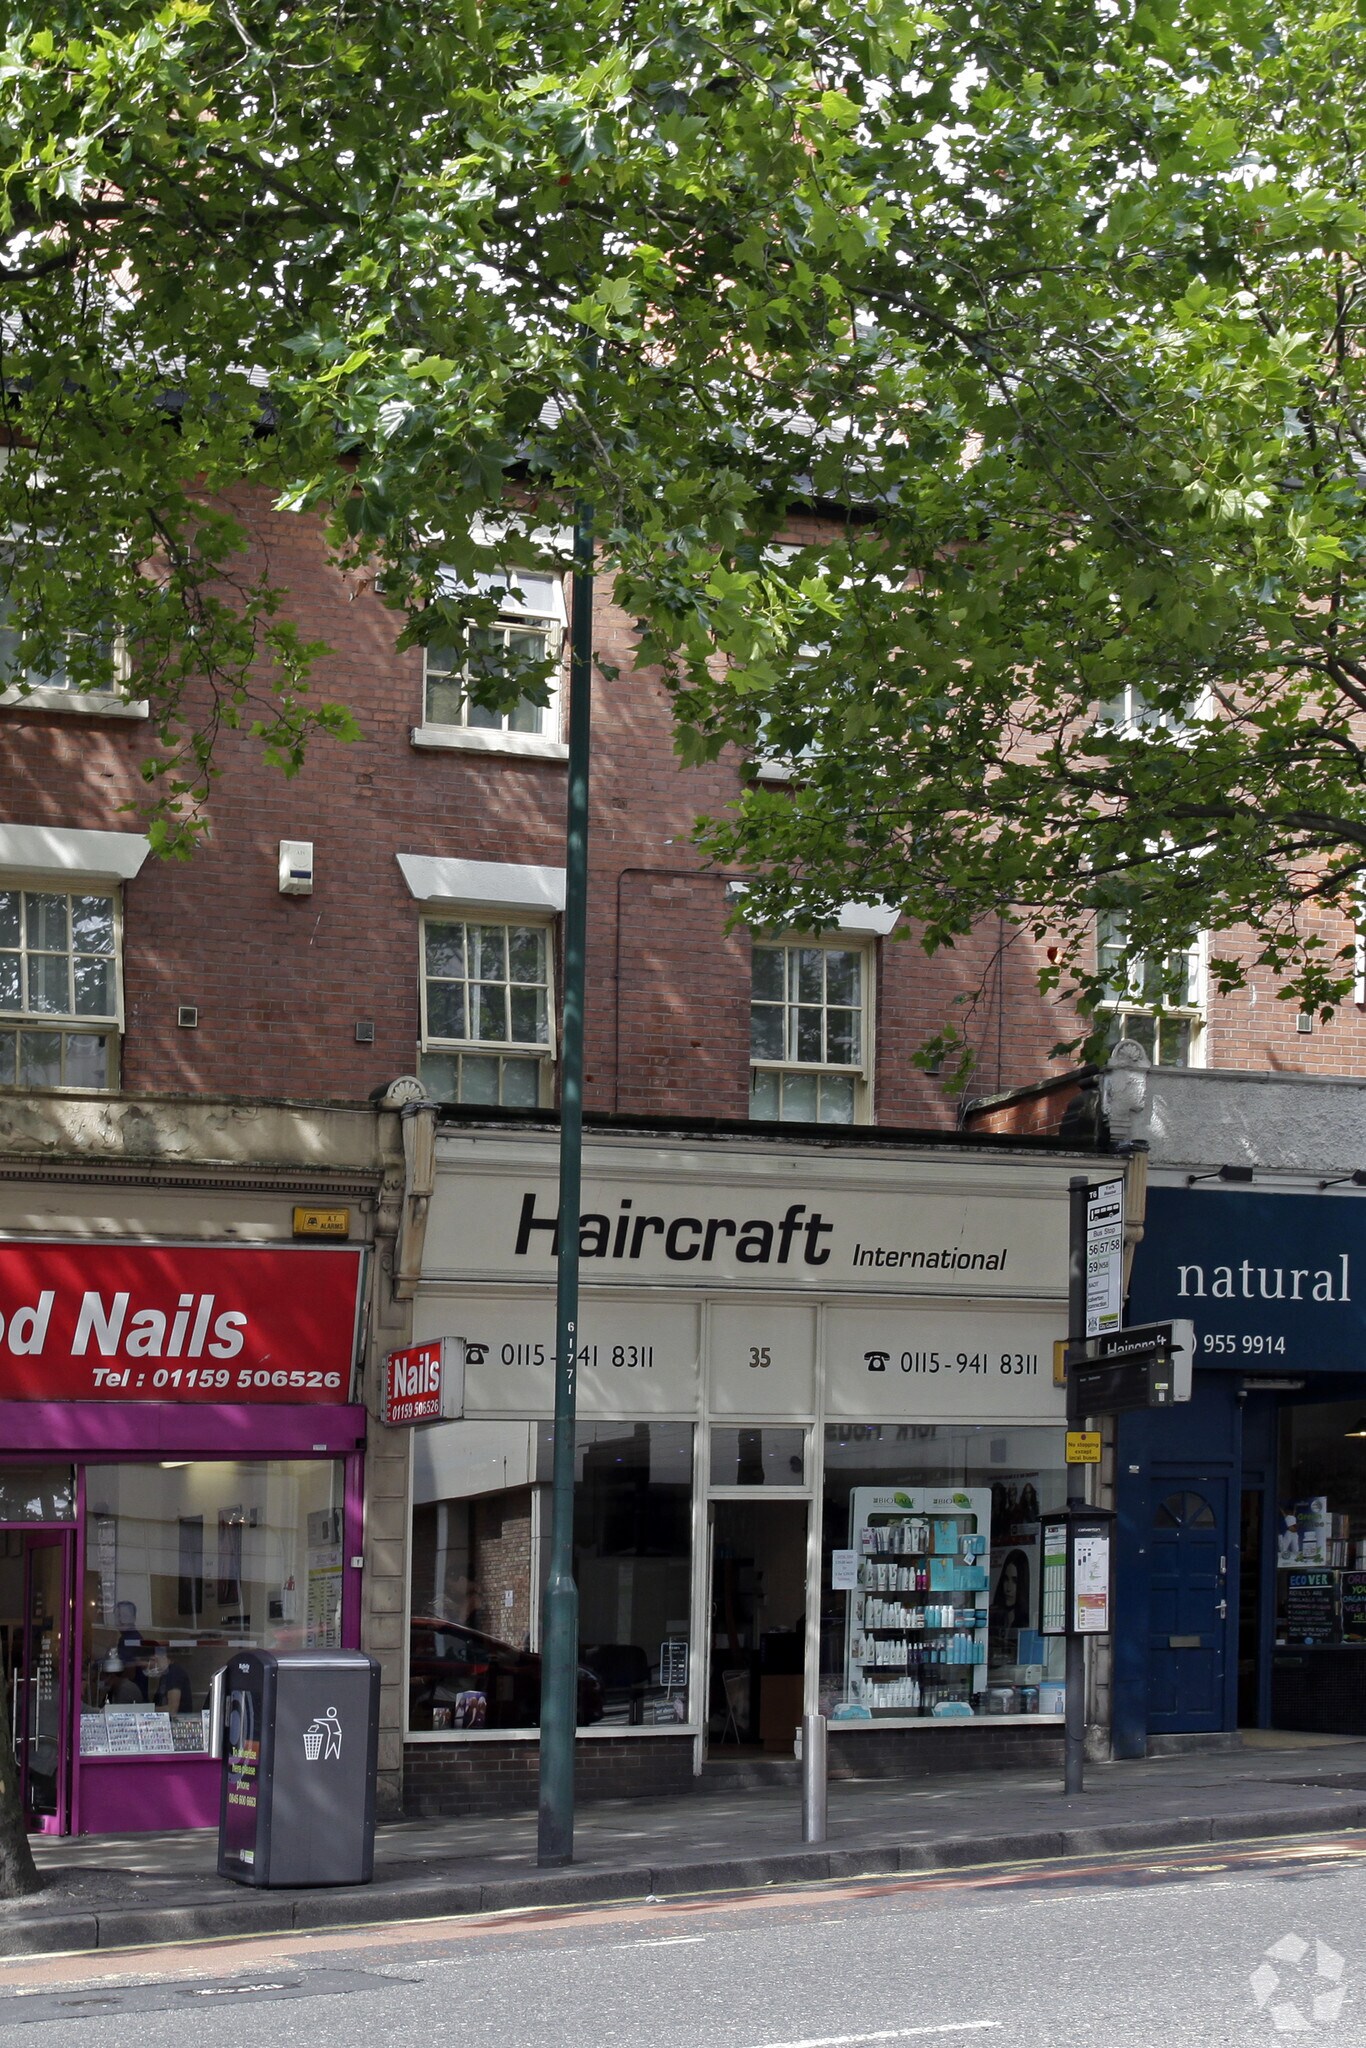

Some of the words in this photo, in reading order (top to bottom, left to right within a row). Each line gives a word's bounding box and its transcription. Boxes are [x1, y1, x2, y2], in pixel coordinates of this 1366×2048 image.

[1089, 1190, 1098, 1199] T6
[515, 1193, 833, 1265] Haircraft
[853, 1244, 1007, 1270] International
[1104, 1227, 1116, 1235] Stop
[1089, 1244, 1098, 1256] 56
[1100, 1242, 1109, 1253] 57
[1110, 1239, 1120, 1251] 58
[1089, 1261, 1098, 1273] 59
[1177, 1254, 1351, 1301] natural
[0, 1291, 55, 1355] d
[71, 1292, 247, 1358] Nails
[1203, 1334, 1236, 1353] 955
[1242, 1335, 1286, 1355] 9914
[612, 1345, 653, 1368] 8311
[749, 1347, 771, 1368] 35
[1000, 1354, 1037, 1374] 8311
[92, 1368, 129, 1387] Tel
[153, 1368, 229, 1388] 01159
[237, 1370, 341, 1388] 506526
[393, 1352, 440, 1398] Nails
[392, 1403, 413, 1420] 01159
[413, 1399, 440, 1417] 506526
[1077, 1441, 1099, 1449] stopping
[231, 1762, 241, 1773] here
[242, 1764, 256, 1776] please
[236, 1779, 250, 1791] phone
